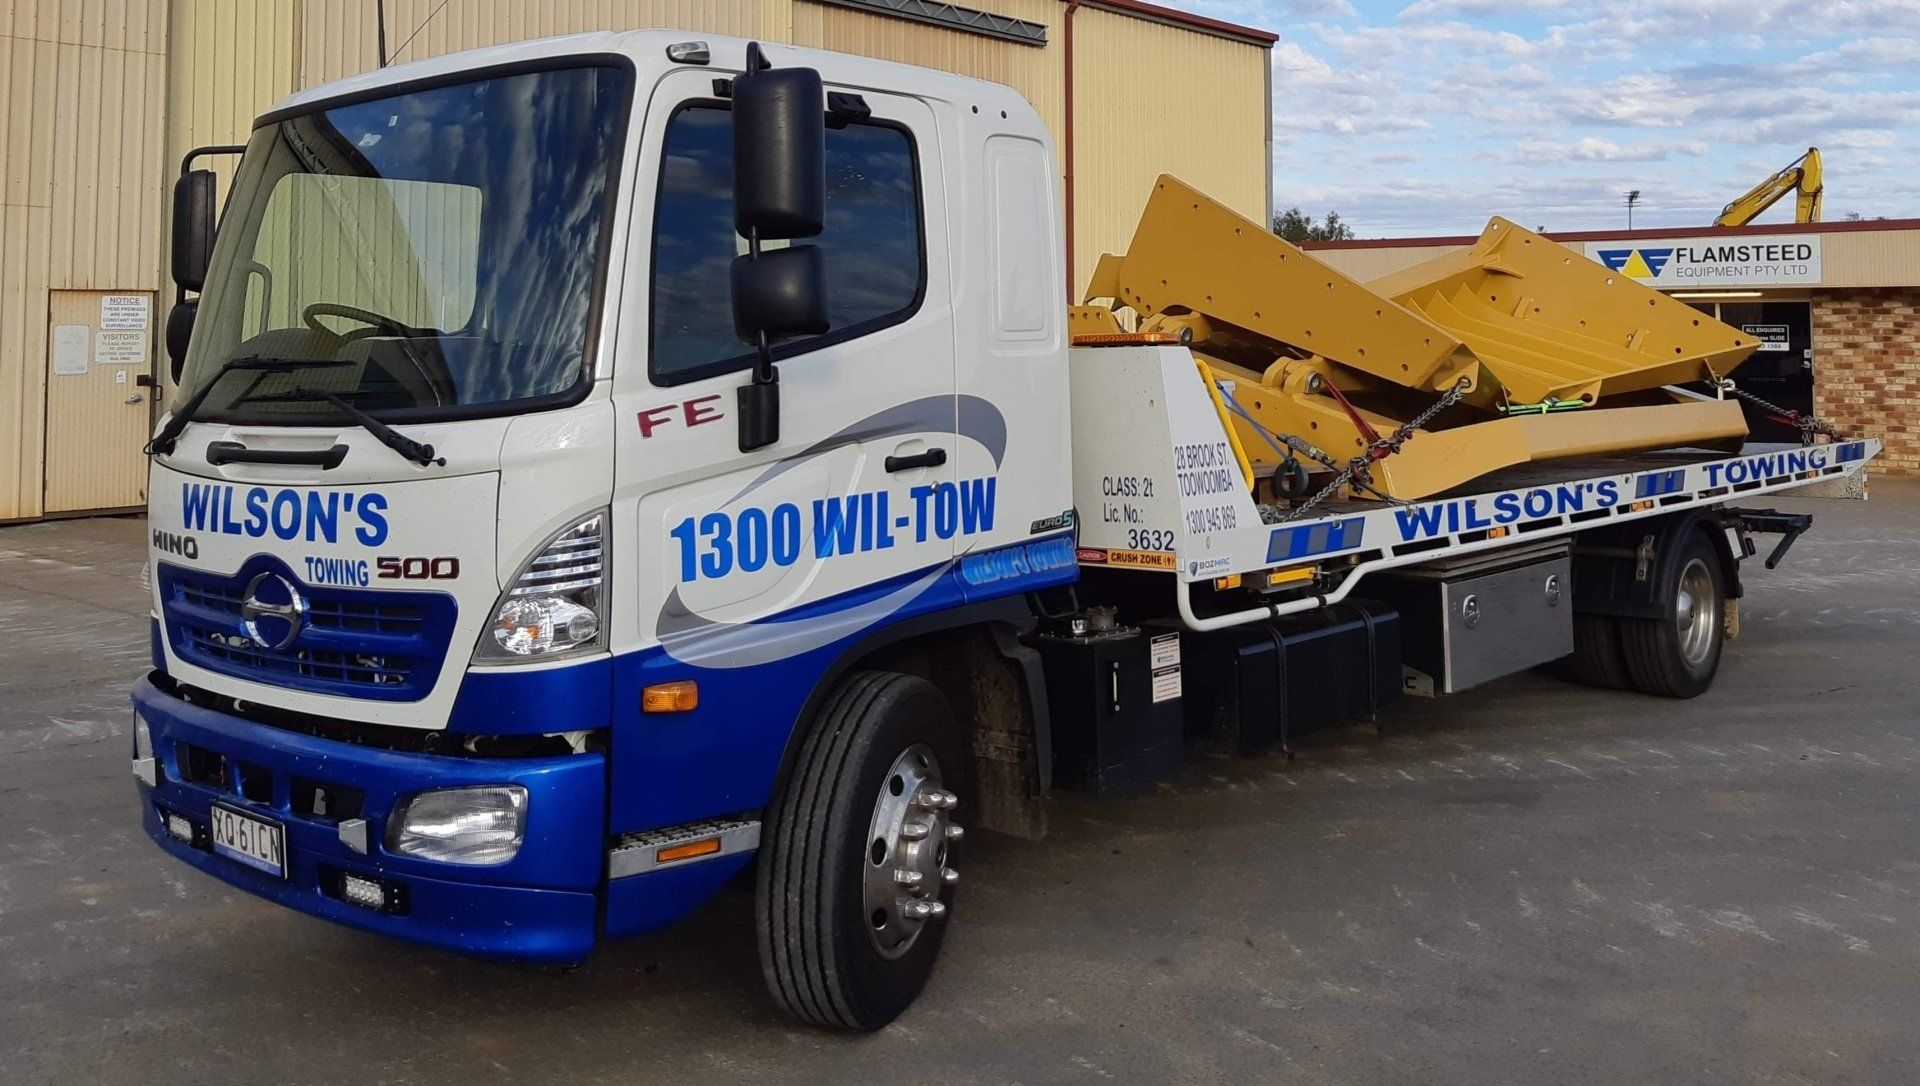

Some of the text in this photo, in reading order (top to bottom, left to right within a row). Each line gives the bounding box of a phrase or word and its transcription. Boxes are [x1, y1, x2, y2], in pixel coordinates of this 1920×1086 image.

[1676, 244, 1812, 263] FLAMSTEED
[1676, 264, 1808, 278] EQUIPMENT PTY LTD
[637, 395, 725, 438] FE
[1175, 442, 1230, 470] 28 BROOK ST.
[1703, 445, 1827, 487] TOWING
[1103, 476, 1154, 498] CLASS: 2t
[1178, 468, 1234, 497] TOOWOOMBA
[183, 483, 389, 547] WILSON'S
[1104, 503, 1144, 524] Lic. No.:
[1186, 504, 1236, 535] 1300 945 869
[1394, 480, 1619, 541] WILSON'S
[153, 529, 198, 559] HINO
[670, 476, 996, 583] 1300 WIL-TOW
[1128, 529, 1175, 551] 3632
[305, 556, 460, 587] TOWING 500
[1079, 551, 1162, 565] CAUTION CRUSH ZONE
[1199, 558, 1230, 569] BOZMAC
